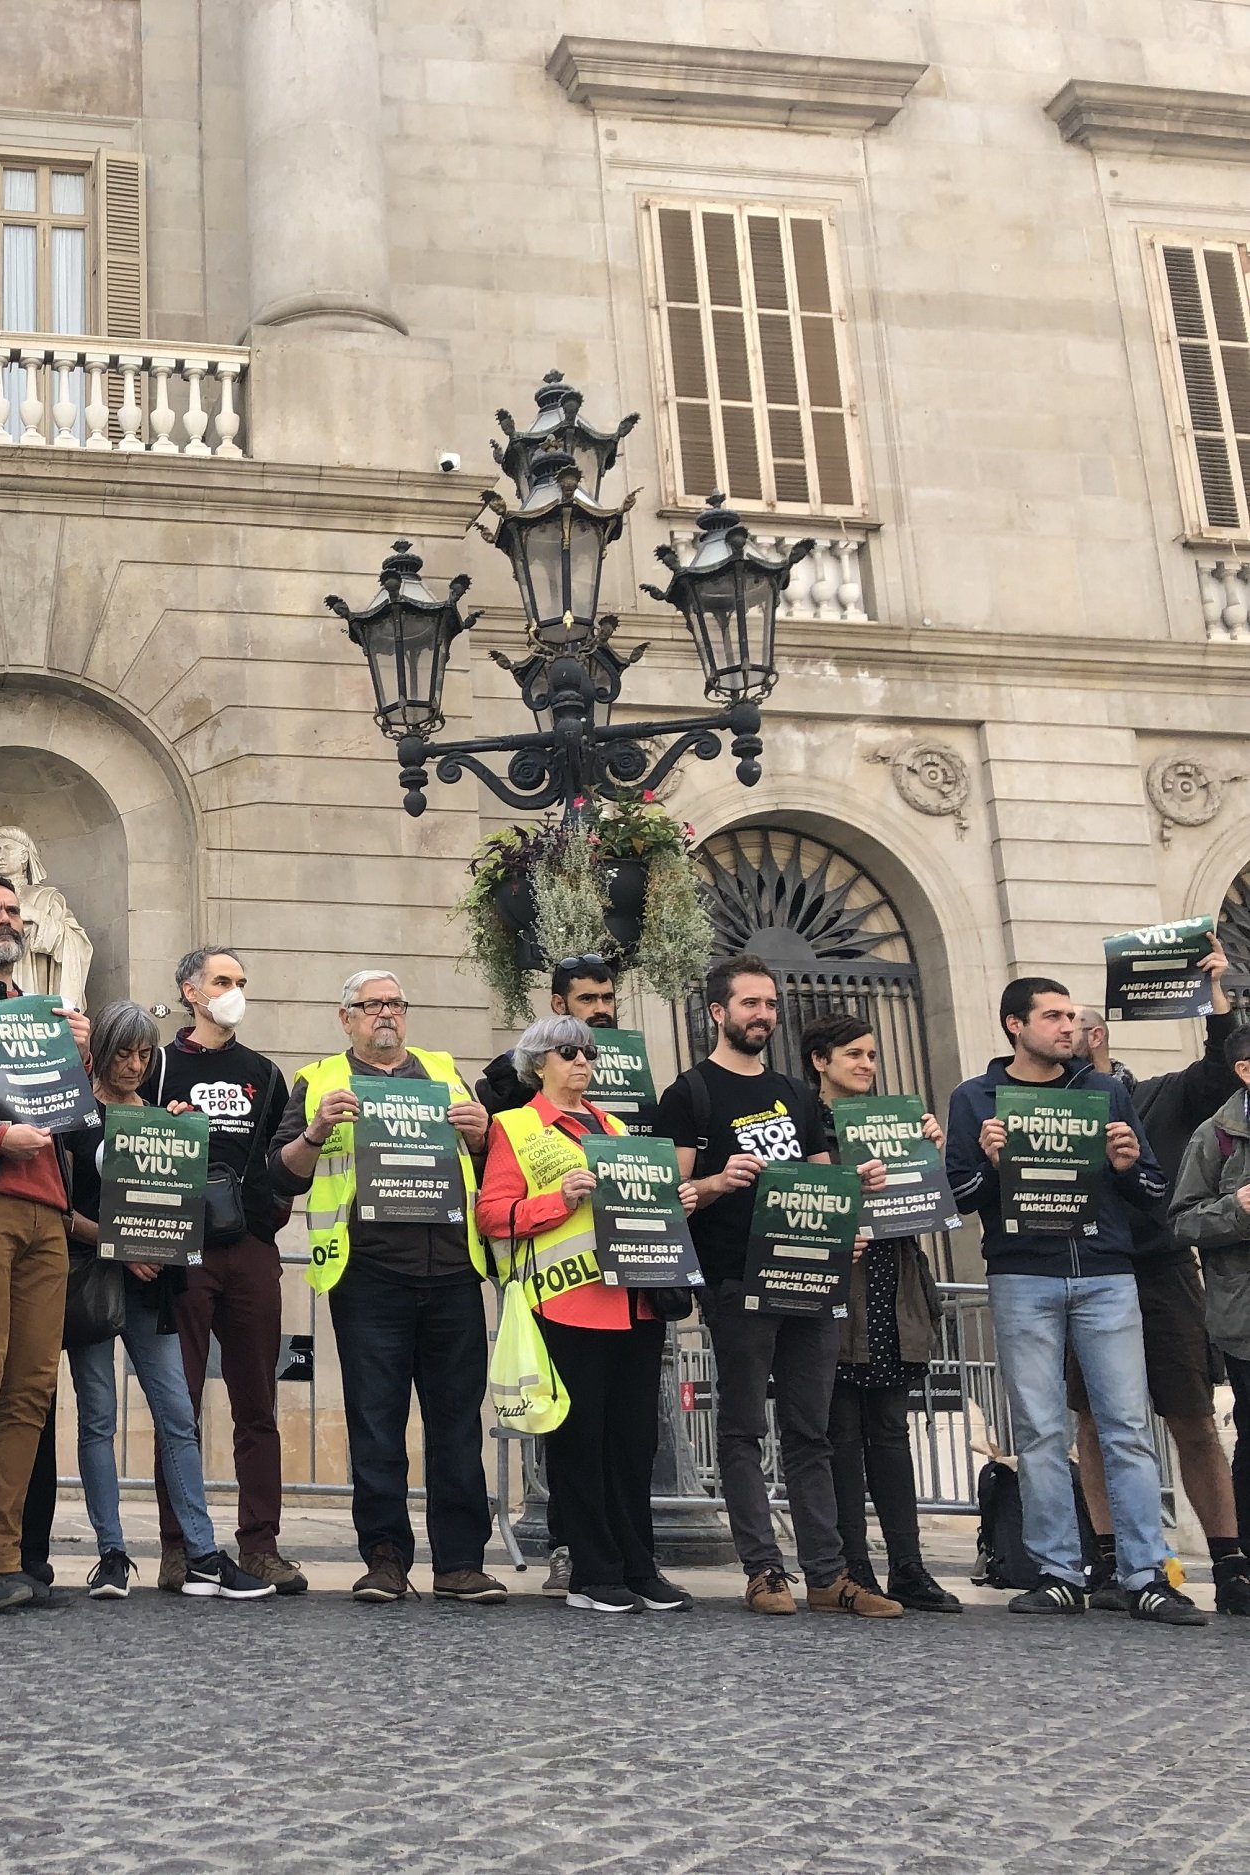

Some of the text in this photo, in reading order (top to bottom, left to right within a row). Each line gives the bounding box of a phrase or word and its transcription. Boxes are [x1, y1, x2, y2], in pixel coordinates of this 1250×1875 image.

[1135, 928, 1184, 945] VIU.
[1119, 980, 1202, 992] ANEM-HI DES DE
[1127, 990, 1194, 1000] BARCELONA!
[0, 1014, 34, 1022] PER UN
[2, 1041, 47, 1058] VIU.
[592, 1070, 630, 1086] VIU.
[6, 1088, 80, 1106] ANEM-HI DES DE
[197, 1088, 238, 1100] ZERO
[386, 1094, 420, 1104] PER UN
[14, 1100, 75, 1116] BARCELONA!
[208, 1100, 246, 1111] PORT
[363, 1102, 445, 1122] PIRINEU
[1034, 1108, 1072, 1117] PER UN
[866, 1114, 898, 1123] PER UN
[1008, 1115, 1098, 1137] PIRINEU
[140, 1126, 176, 1138] PER UN
[384, 1120, 428, 1139] VIU.
[737, 1122, 796, 1151] STOP
[846, 1122, 923, 1143] PIRINEU
[115, 1134, 200, 1159] PIRINEU
[866, 1142, 910, 1158] VIU.
[1028, 1134, 1074, 1153] VIU.
[528, 1144, 563, 1162] CONTRA
[616, 1154, 648, 1164] PER UN
[134, 1154, 178, 1176] VIU.
[598, 1162, 673, 1184] PIRINEU
[116, 1177, 140, 1186] ATUREM
[370, 1178, 450, 1190] ANEM-HI DES DE
[794, 1183, 828, 1194] PER UN
[378, 1188, 442, 1199] BARCELONA!
[617, 1182, 657, 1202] VIU.
[862, 1191, 942, 1208] ANEM-HI DES DE
[1013, 1192, 1088, 1204] ANEM-HI DES DE
[766, 1190, 851, 1214] PIRINEU
[1020, 1204, 1080, 1214] BARCELONA!
[872, 1203, 936, 1218] BARCELONA!
[113, 1216, 193, 1231] ANEM-HI DES DE
[786, 1210, 828, 1231] VIU.
[120, 1227, 184, 1241] BARCELONA!
[609, 1244, 684, 1254] ANEM-HI DES DE
[618, 1254, 679, 1264] BARCELONA!
[532, 1250, 601, 1298] POBL
[758, 1269, 840, 1284] ANEM-HI DES DE
[765, 1280, 830, 1294] BARCELONA!
